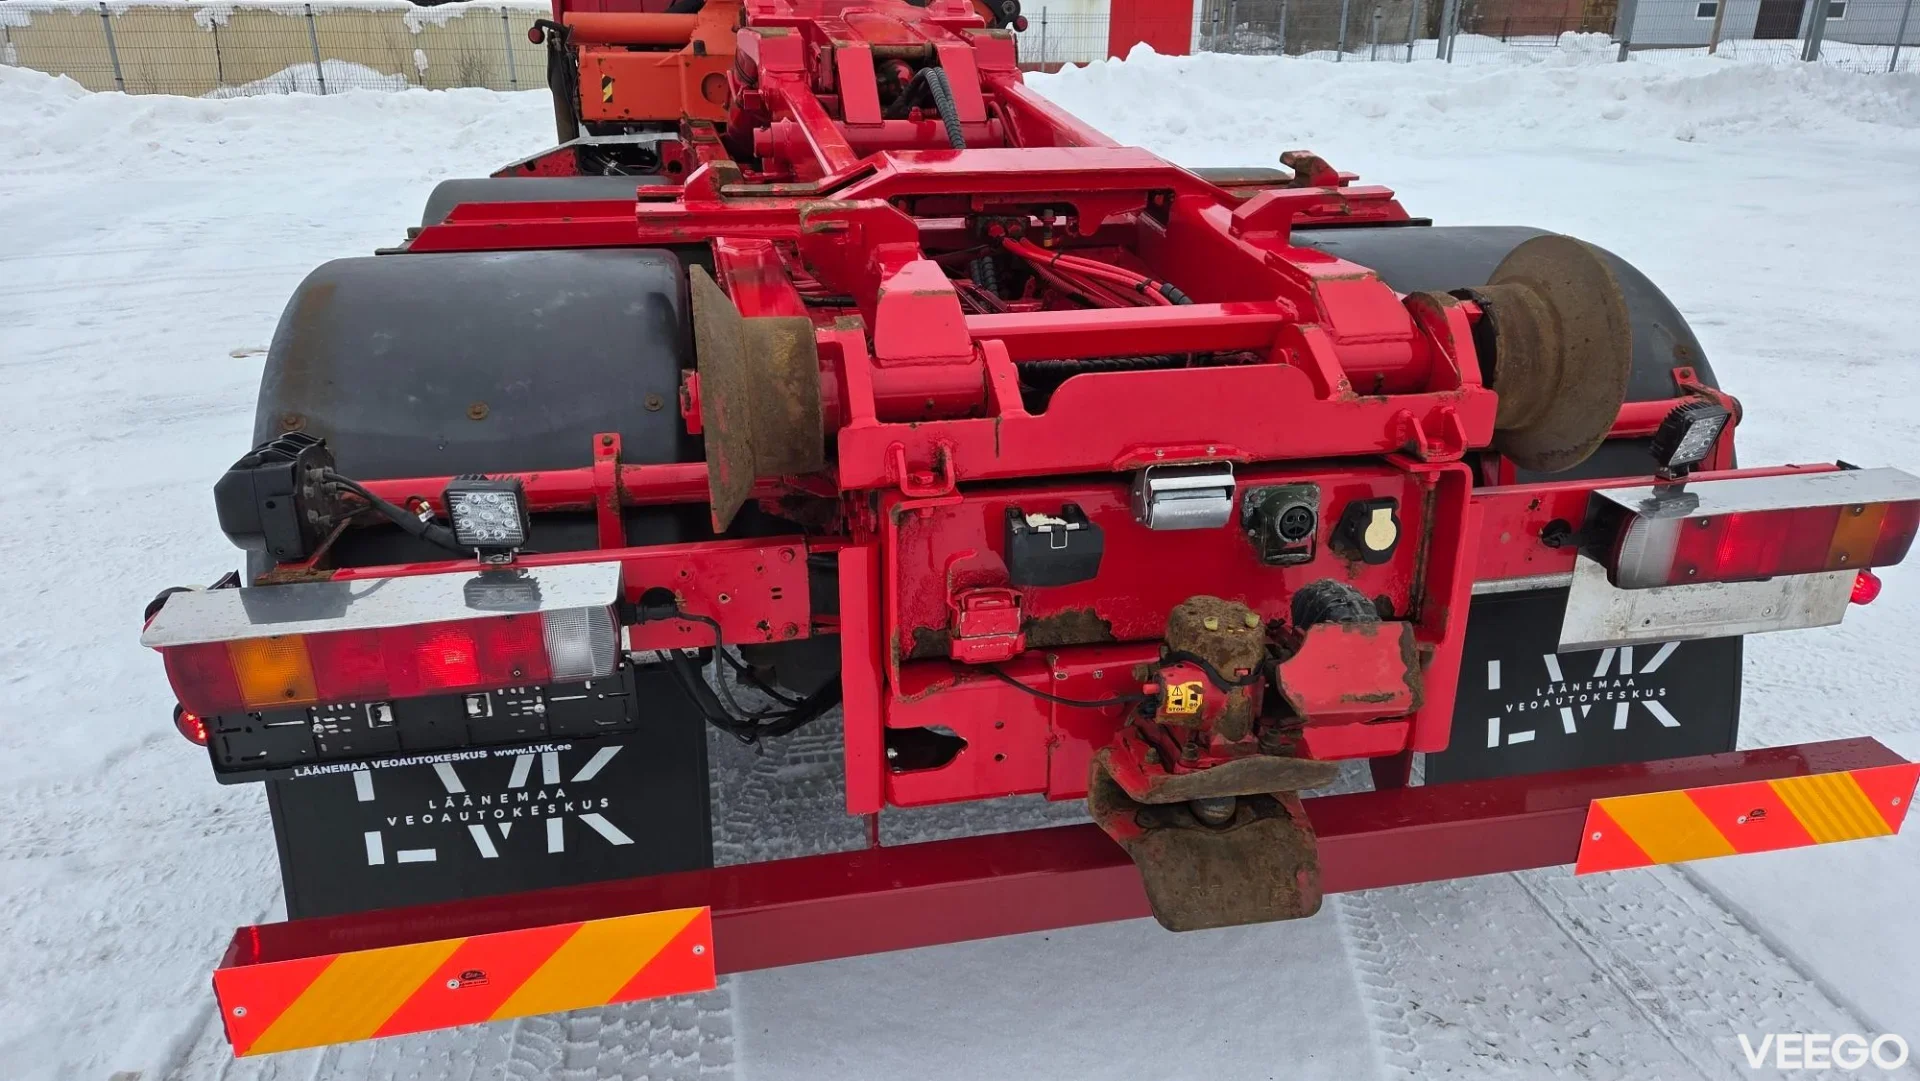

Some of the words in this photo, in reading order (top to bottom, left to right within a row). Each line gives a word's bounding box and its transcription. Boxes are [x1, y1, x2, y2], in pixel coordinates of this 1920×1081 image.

[1505, 687, 1667, 713] VEOAUTOKESKUS
[1536, 678, 1635, 697] LÄÄNEMAA
[294, 762, 369, 777] LÄÄNEMAA
[371, 750, 488, 769] VEOAUTOKESKUS
[494, 743, 572, 757] www.LVK.ee
[429, 788, 566, 809] LÄÄNEMAA
[387, 798, 609, 827] VEOAUTOKESKUS
